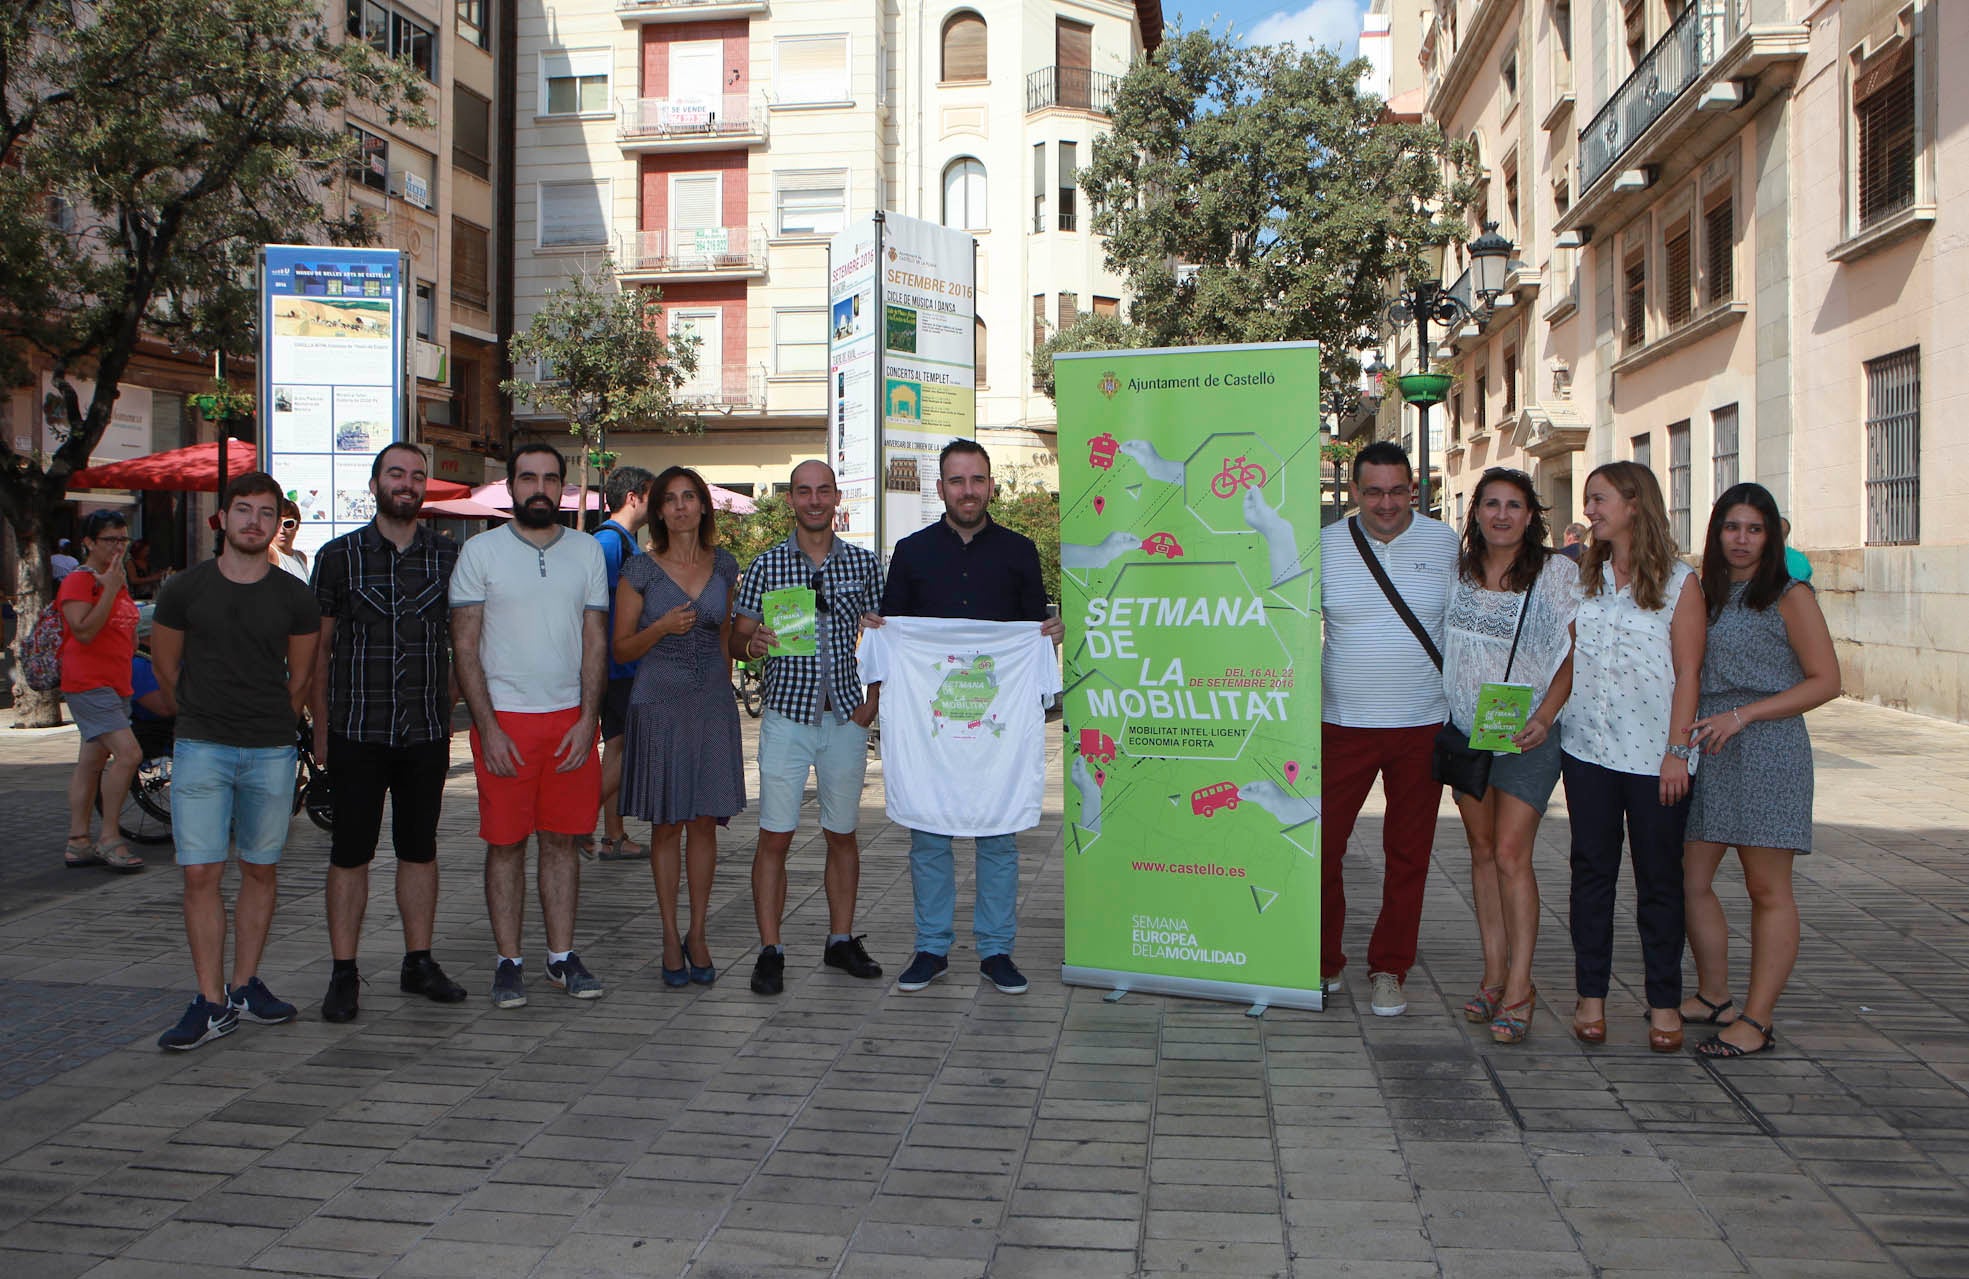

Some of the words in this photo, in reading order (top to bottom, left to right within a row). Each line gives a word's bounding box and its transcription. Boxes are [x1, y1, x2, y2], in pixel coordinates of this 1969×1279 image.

[683, 104, 706, 112] VENDE
[833, 256, 860, 282] SETEMBRE
[860, 248, 874, 268] 2016
[888, 268, 946, 294] SETEMBRE
[948, 282, 973, 299] 2016
[887, 290, 902, 304] CICLE
[904, 294, 910, 306] DE
[938, 300, 956, 312] DANSA
[886, 366, 914, 380] CONCERTS
[915, 370, 923, 380] AL
[922, 372, 950, 384] TEMPLET
[1128, 376, 1200, 393] Ajuntament
[1204, 374, 1220, 387] de
[1224, 371, 1275, 386] Castelló
[1084, 597, 1266, 626] SETMANA
[1085, 630, 1138, 659] DE
[1138, 658, 1184, 686] LA
[1226, 668, 1246, 677] DEL
[1250, 668, 1262, 677] 16
[1264, 668, 1278, 678] AL
[1282, 668, 1294, 678] 22
[943, 680, 984, 688] SETMANA
[1189, 678, 1203, 687] DE
[1207, 679, 1266, 688] SETEMBRE
[1270, 680, 1294, 688] 2016
[941, 700, 990, 710] MOBILITAT
[1086, 689, 1290, 720] MOBILITAT
[1129, 726, 1178, 736] MOBILITAT
[1129, 738, 1180, 746] ECONOMIA
[1182, 739, 1214, 748] FORTA
[1132, 861, 1246, 878] www.castello.es
[1132, 914, 1190, 931] SEMANA
[1132, 930, 1198, 946] EUROPEA
